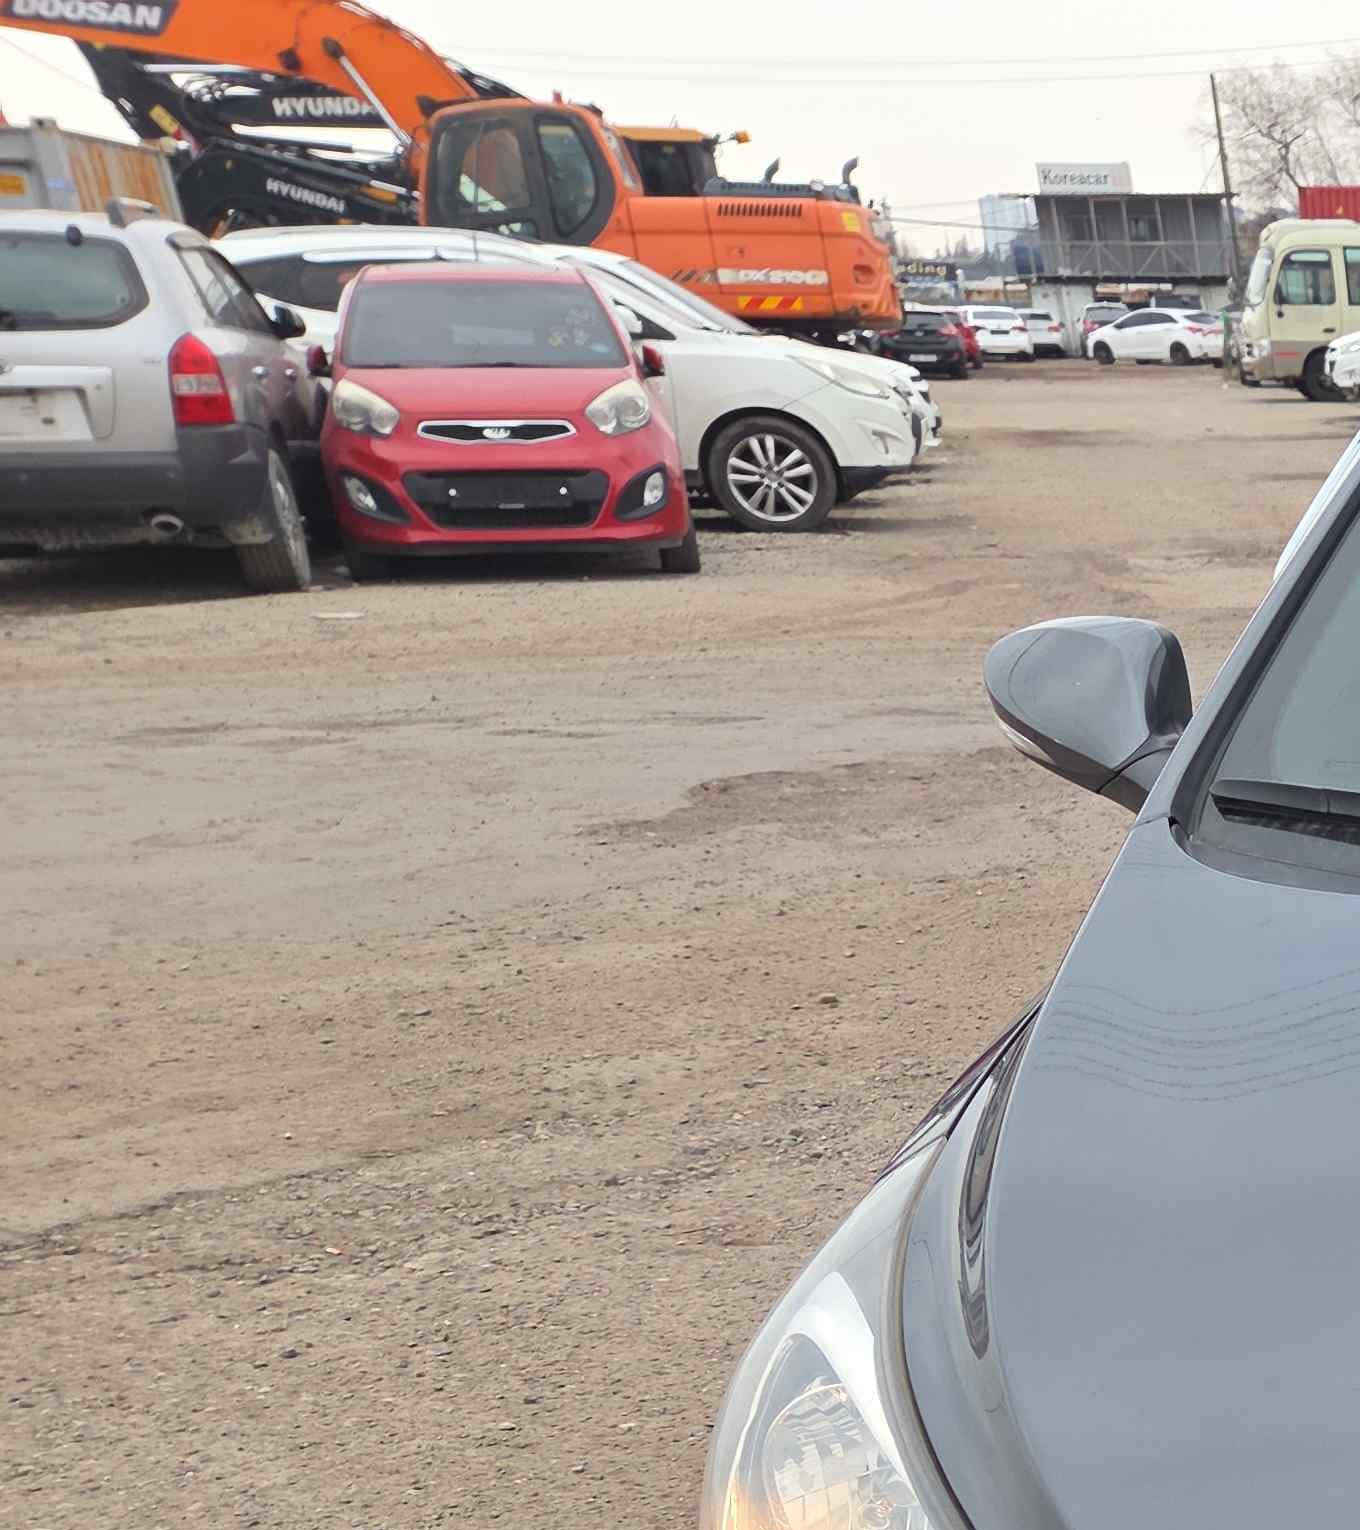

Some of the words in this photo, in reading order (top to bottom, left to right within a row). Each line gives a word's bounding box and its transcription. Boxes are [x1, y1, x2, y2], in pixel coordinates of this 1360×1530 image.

[12, 0, 162, 29] DOOSAN
[272, 96, 381, 117] HYUNDA
[266, 177, 346, 214] HYUNDAI
